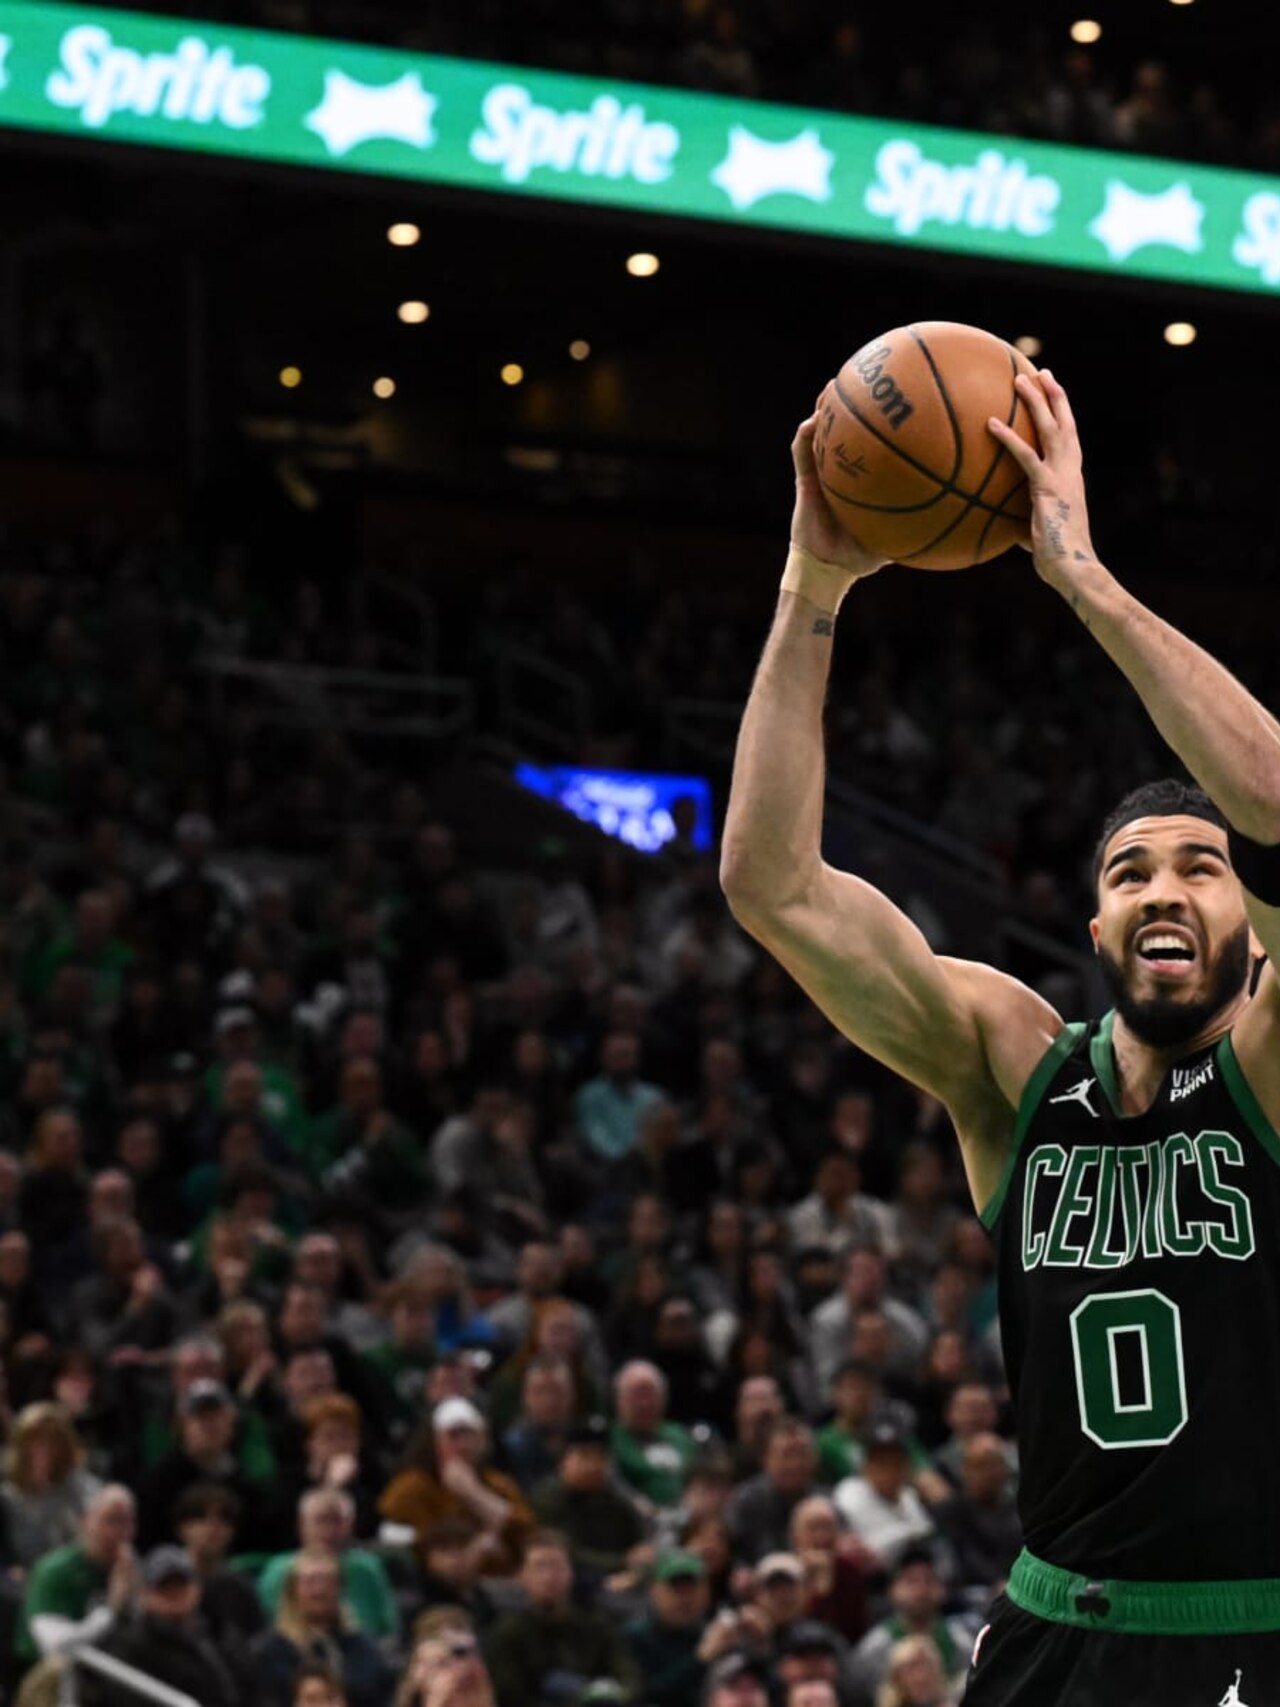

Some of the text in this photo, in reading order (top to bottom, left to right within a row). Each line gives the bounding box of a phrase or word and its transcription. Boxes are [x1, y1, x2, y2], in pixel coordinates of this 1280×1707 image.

[46, 25, 270, 127] Sprite
[469, 84, 680, 184] Sprite
[864, 139, 1062, 236] Sprite
[1022, 1130, 1255, 1272] CELTICS
[1069, 1288, 1188, 1449] 0
